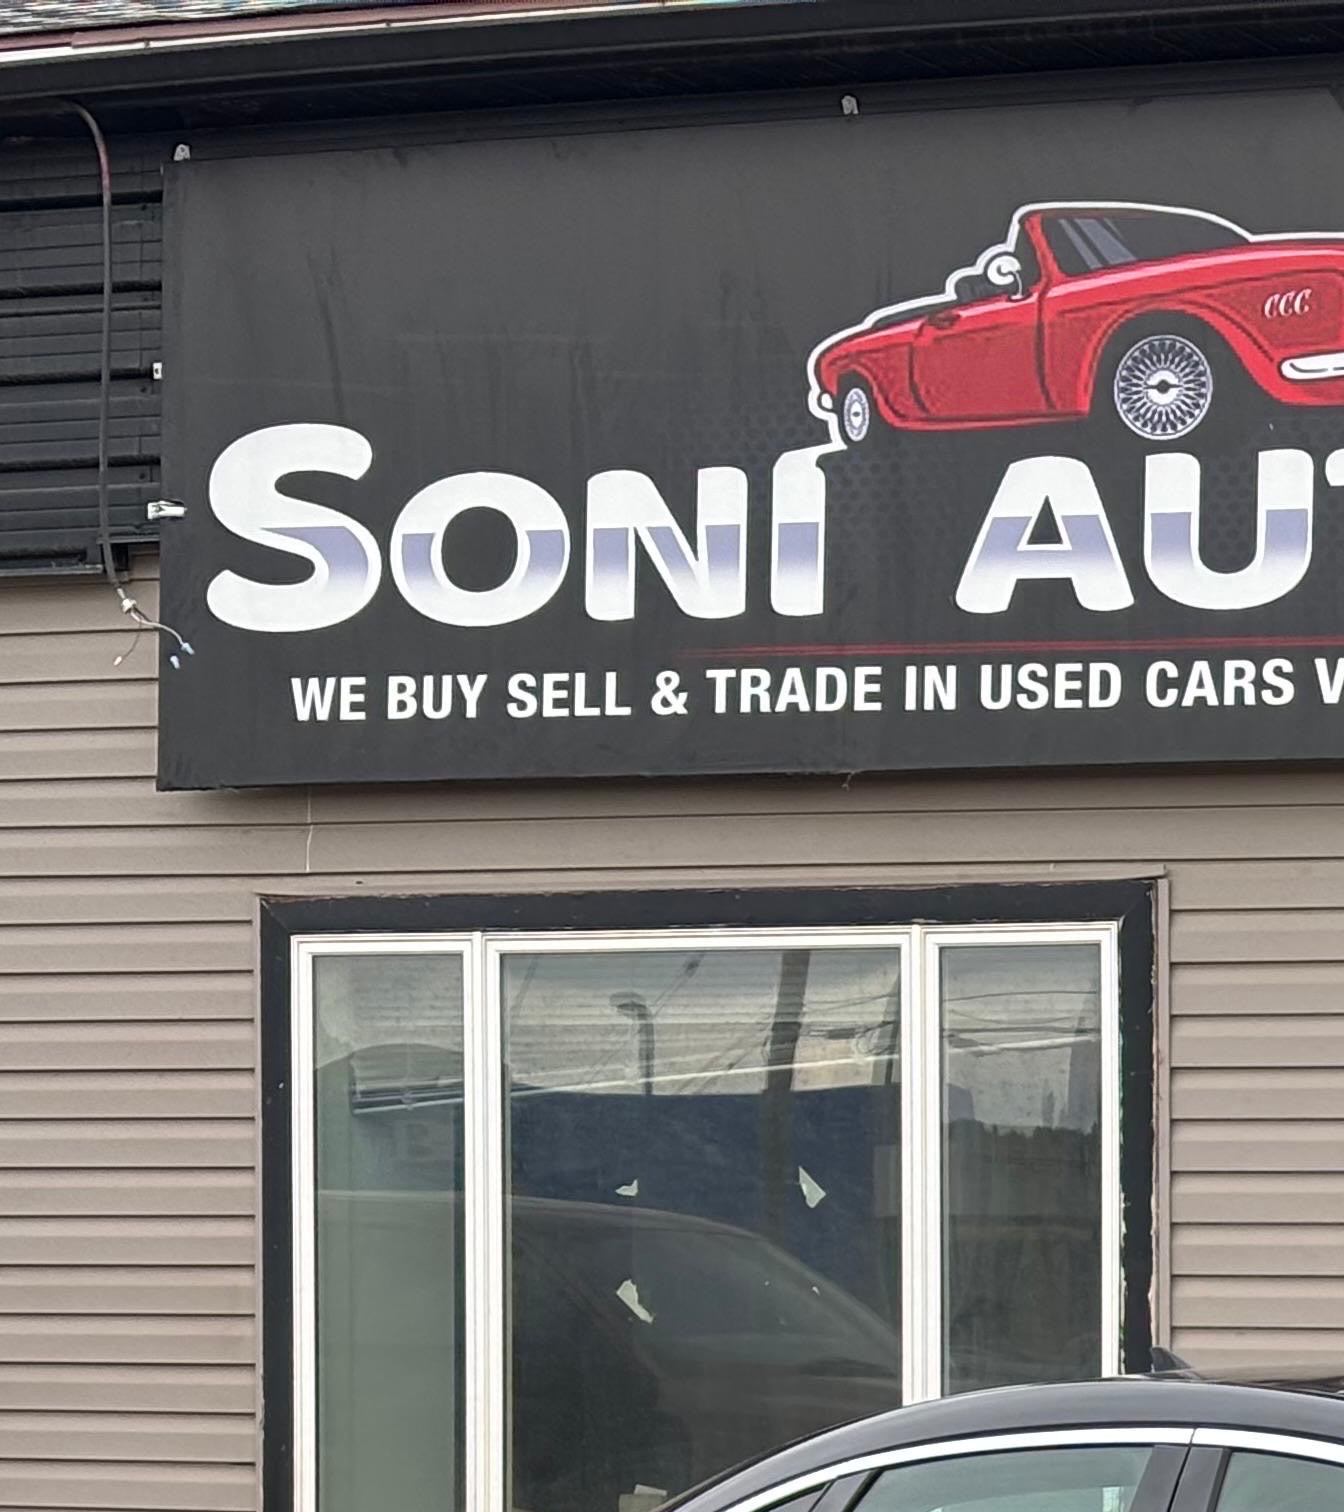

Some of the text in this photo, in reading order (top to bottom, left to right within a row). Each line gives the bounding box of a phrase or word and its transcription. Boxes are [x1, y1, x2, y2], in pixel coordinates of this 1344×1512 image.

[291, 676, 366, 722] WE
[388, 674, 487, 720] BUY
[507, 672, 631, 719] SELL
[650, 670, 689, 716] &
[706, 666, 881, 714] TRADE
[904, 664, 957, 711] IN
[980, 662, 1121, 710] USED
[1145, 658, 1294, 708] CARS
